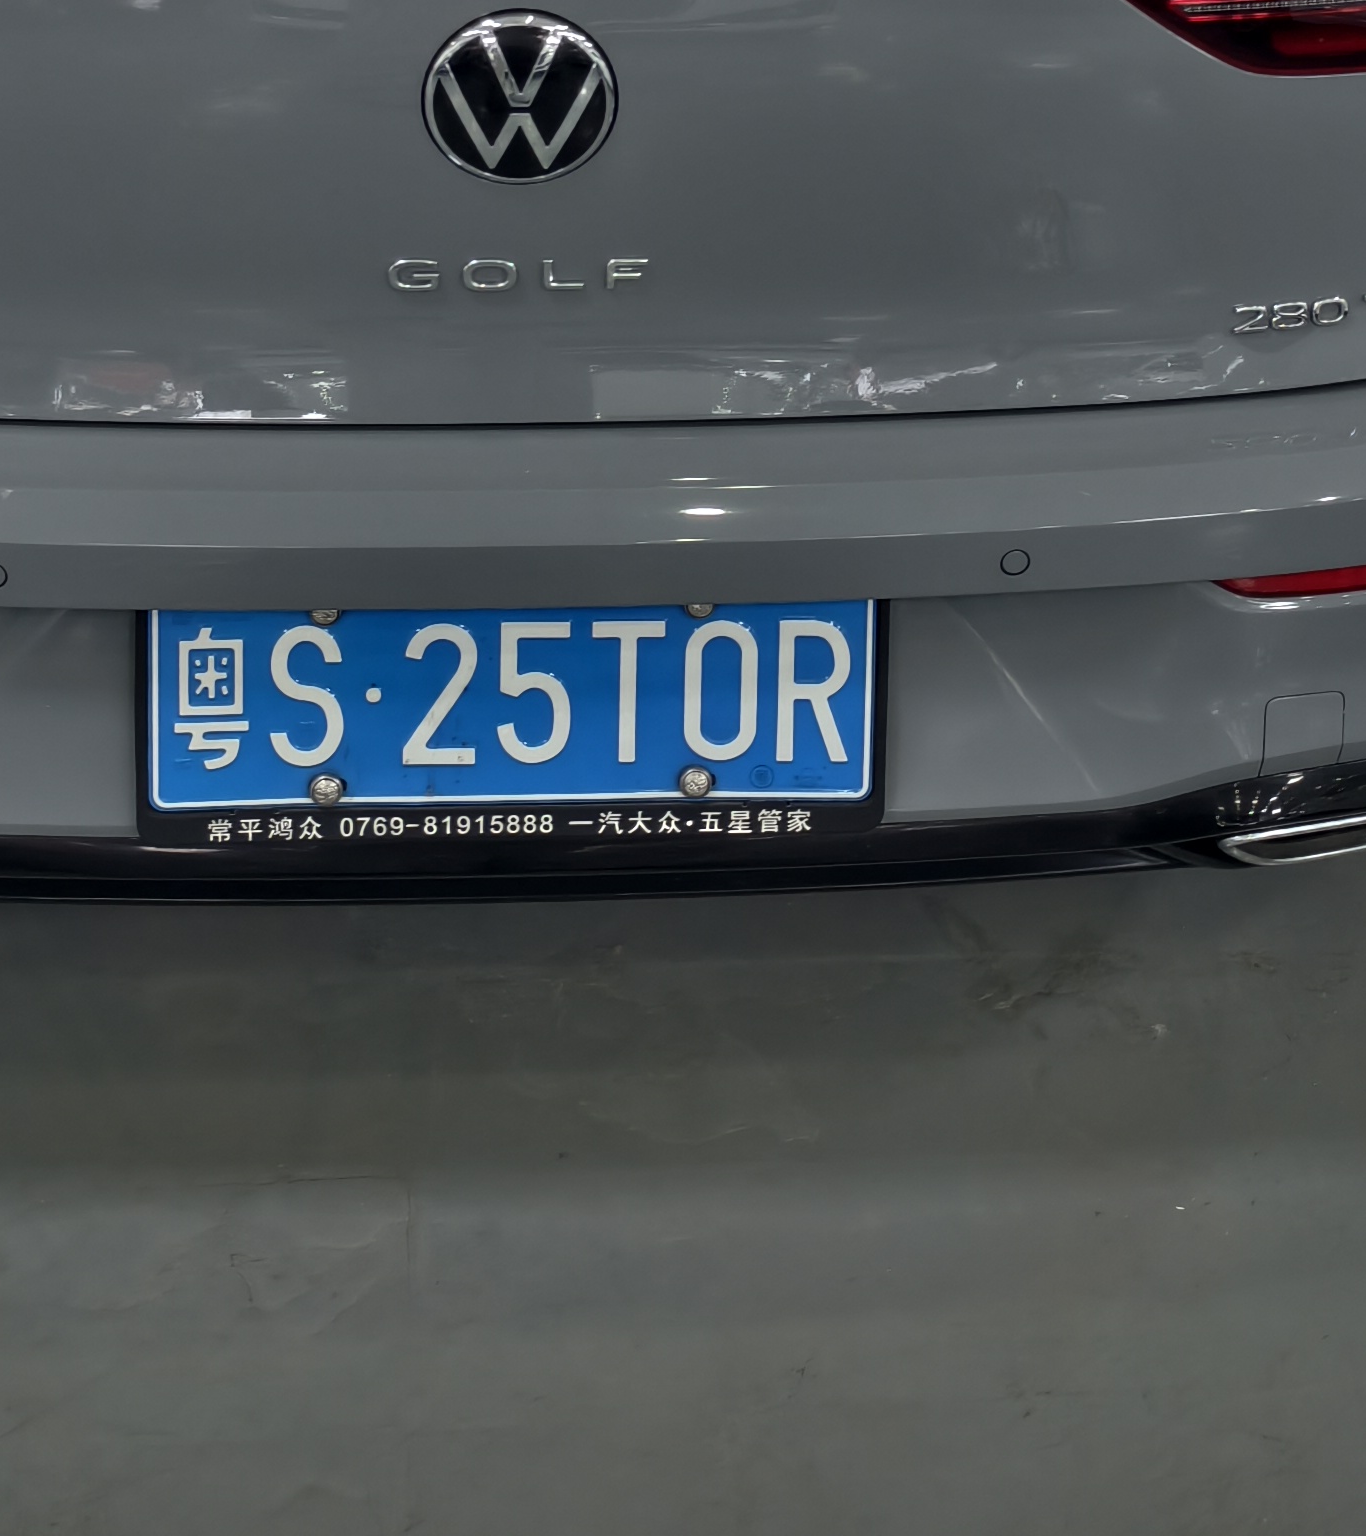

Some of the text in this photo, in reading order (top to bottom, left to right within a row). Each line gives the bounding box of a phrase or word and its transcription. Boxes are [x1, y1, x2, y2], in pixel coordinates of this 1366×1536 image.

[388, 258, 649, 292] GOLF
[1233, 296, 1349, 334] 280
[207, 809, 813, 843] 常平鸿众 0769-81915888 一汽大众·五星管家
